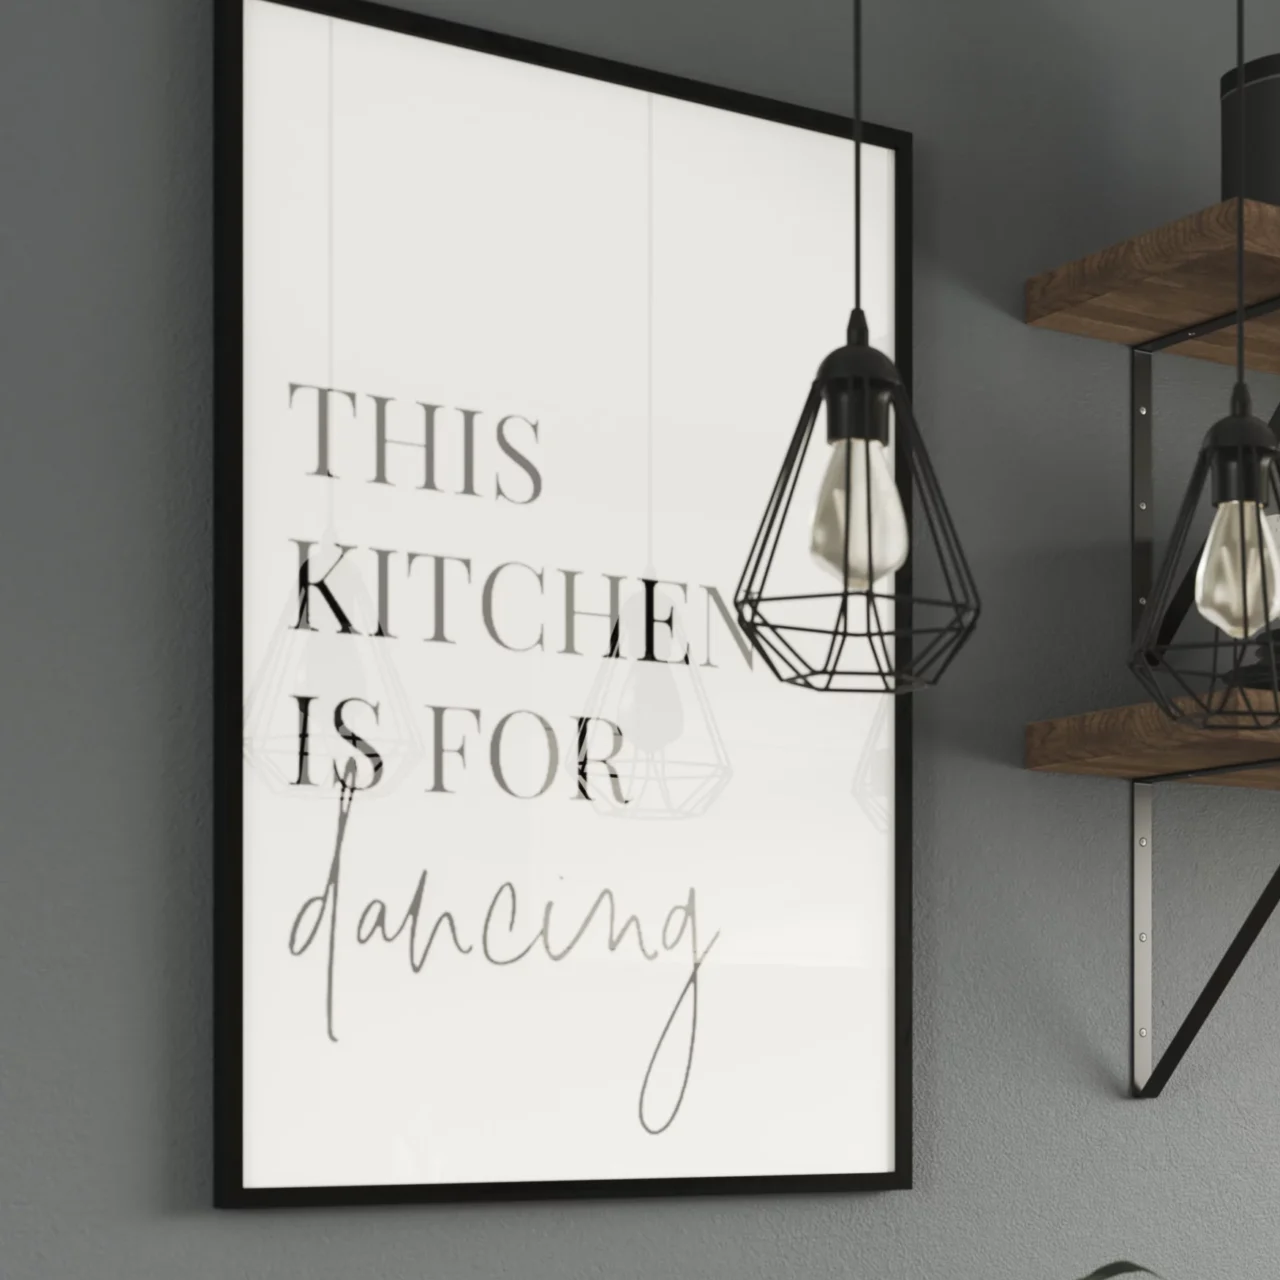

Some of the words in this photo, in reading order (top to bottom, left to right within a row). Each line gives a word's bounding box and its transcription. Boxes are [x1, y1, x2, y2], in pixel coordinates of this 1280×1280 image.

[288, 382, 543, 505] THIS
[288, 538, 761, 672] KITCHEN
[289, 695, 384, 791] IS
[424, 705, 632, 805] FOR
[289, 757, 721, 1135] dancing
